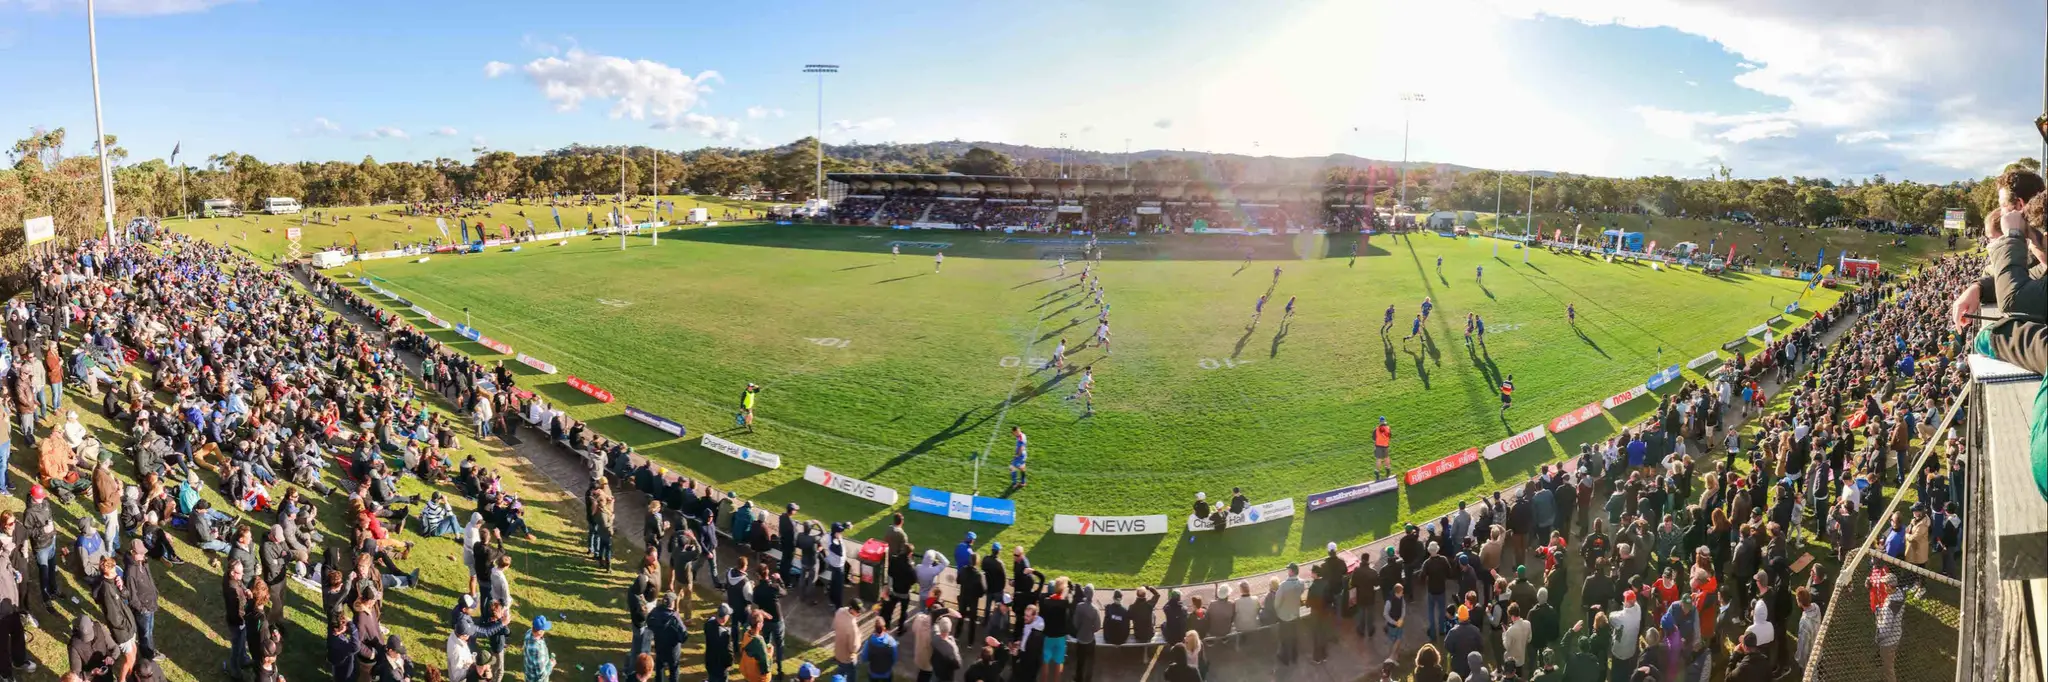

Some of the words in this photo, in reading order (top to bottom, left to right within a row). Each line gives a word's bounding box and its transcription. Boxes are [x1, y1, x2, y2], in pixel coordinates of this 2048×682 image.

[1612, 391, 1633, 405] nova
[704, 437, 728, 451] Charter
[727, 445, 740, 455] Hall
[1500, 431, 1535, 453] Canon
[1436, 460, 1455, 474] FUJITSU
[1411, 469, 1432, 483] FUJITSU
[1325, 487, 1369, 503] austbrokers
[952, 500, 970, 512] 50m
[1229, 512, 1246, 525] Hall
